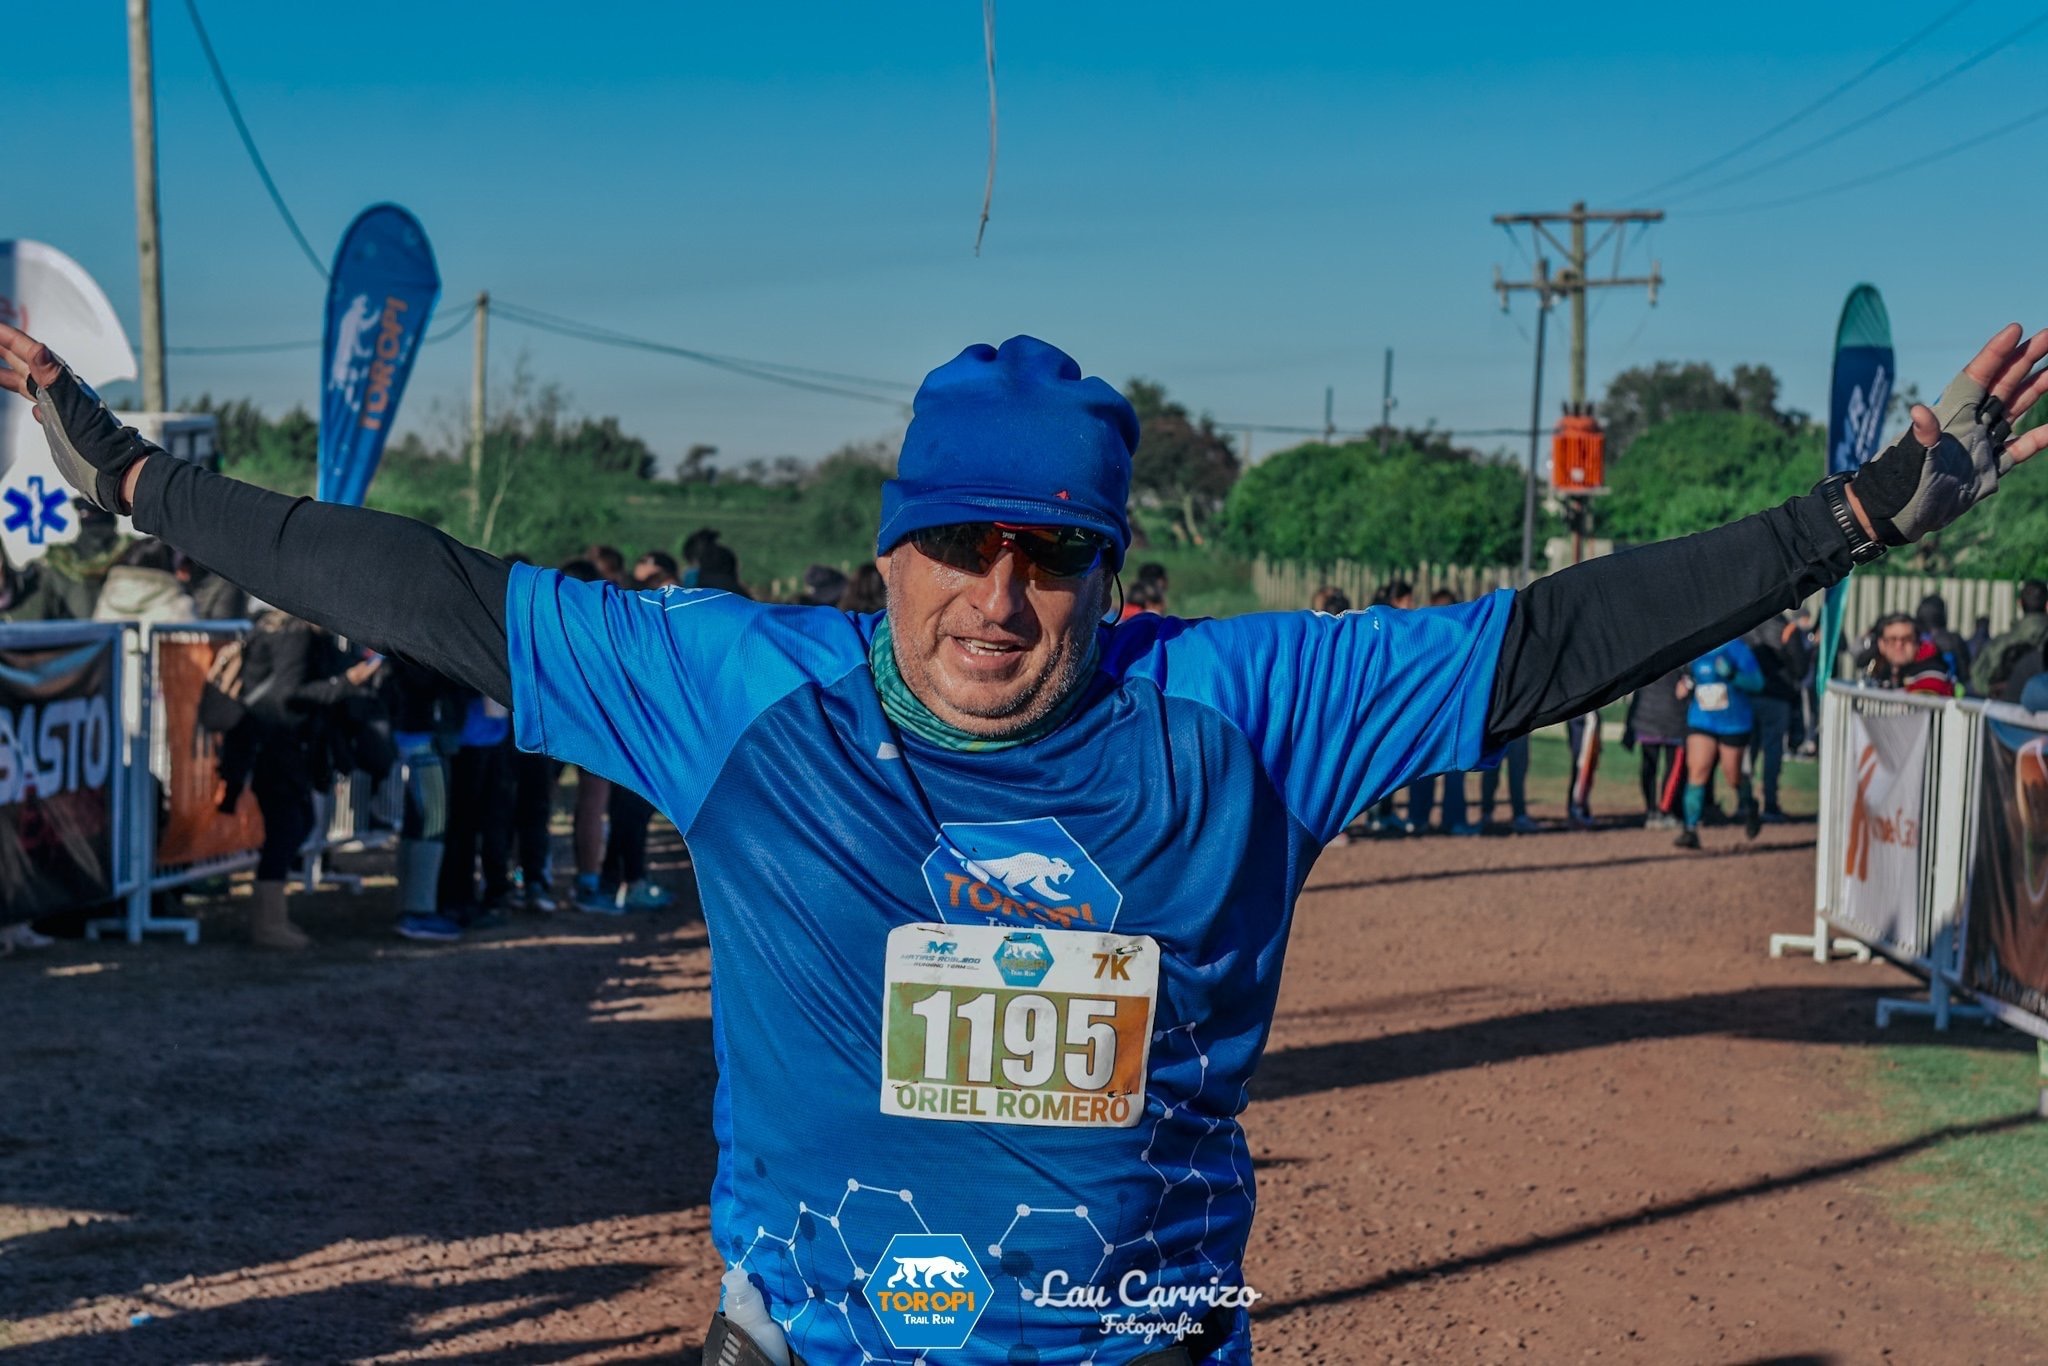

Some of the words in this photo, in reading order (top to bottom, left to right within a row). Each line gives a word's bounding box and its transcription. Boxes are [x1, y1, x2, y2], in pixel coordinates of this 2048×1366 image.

[1092, 953, 1132, 981] 7K
[912, 990, 1117, 1091] 1195
[896, 1085, 986, 1116] ORIEL
[996, 1088, 1130, 1123] ROMERO
